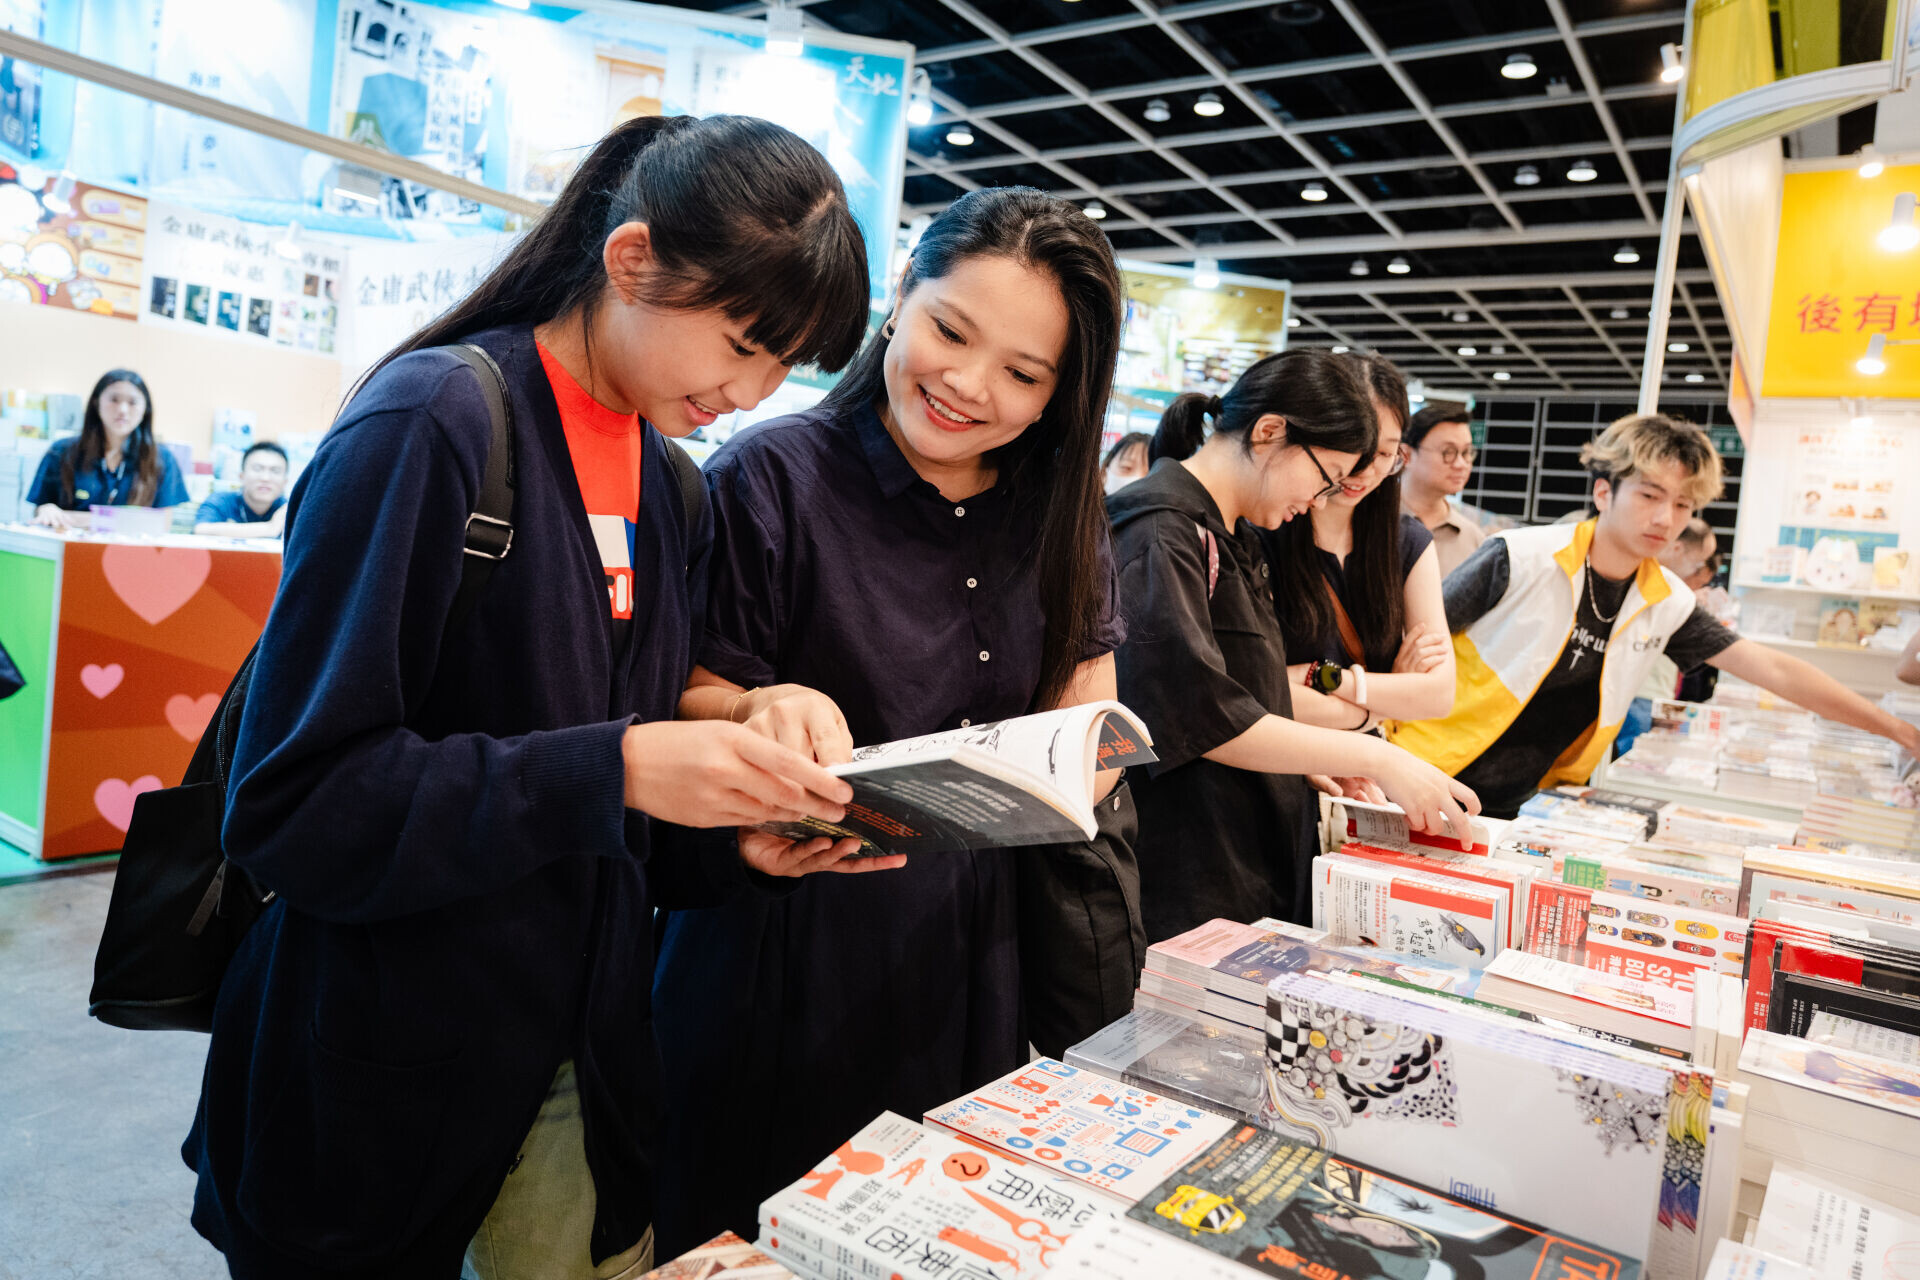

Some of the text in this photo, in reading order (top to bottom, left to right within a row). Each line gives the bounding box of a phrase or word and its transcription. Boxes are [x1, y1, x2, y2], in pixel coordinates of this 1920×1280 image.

[845, 56, 899, 96] 天地
[1797, 291, 1920, 334] 後有
[836, 1183, 903, 1237] 生活百貨
